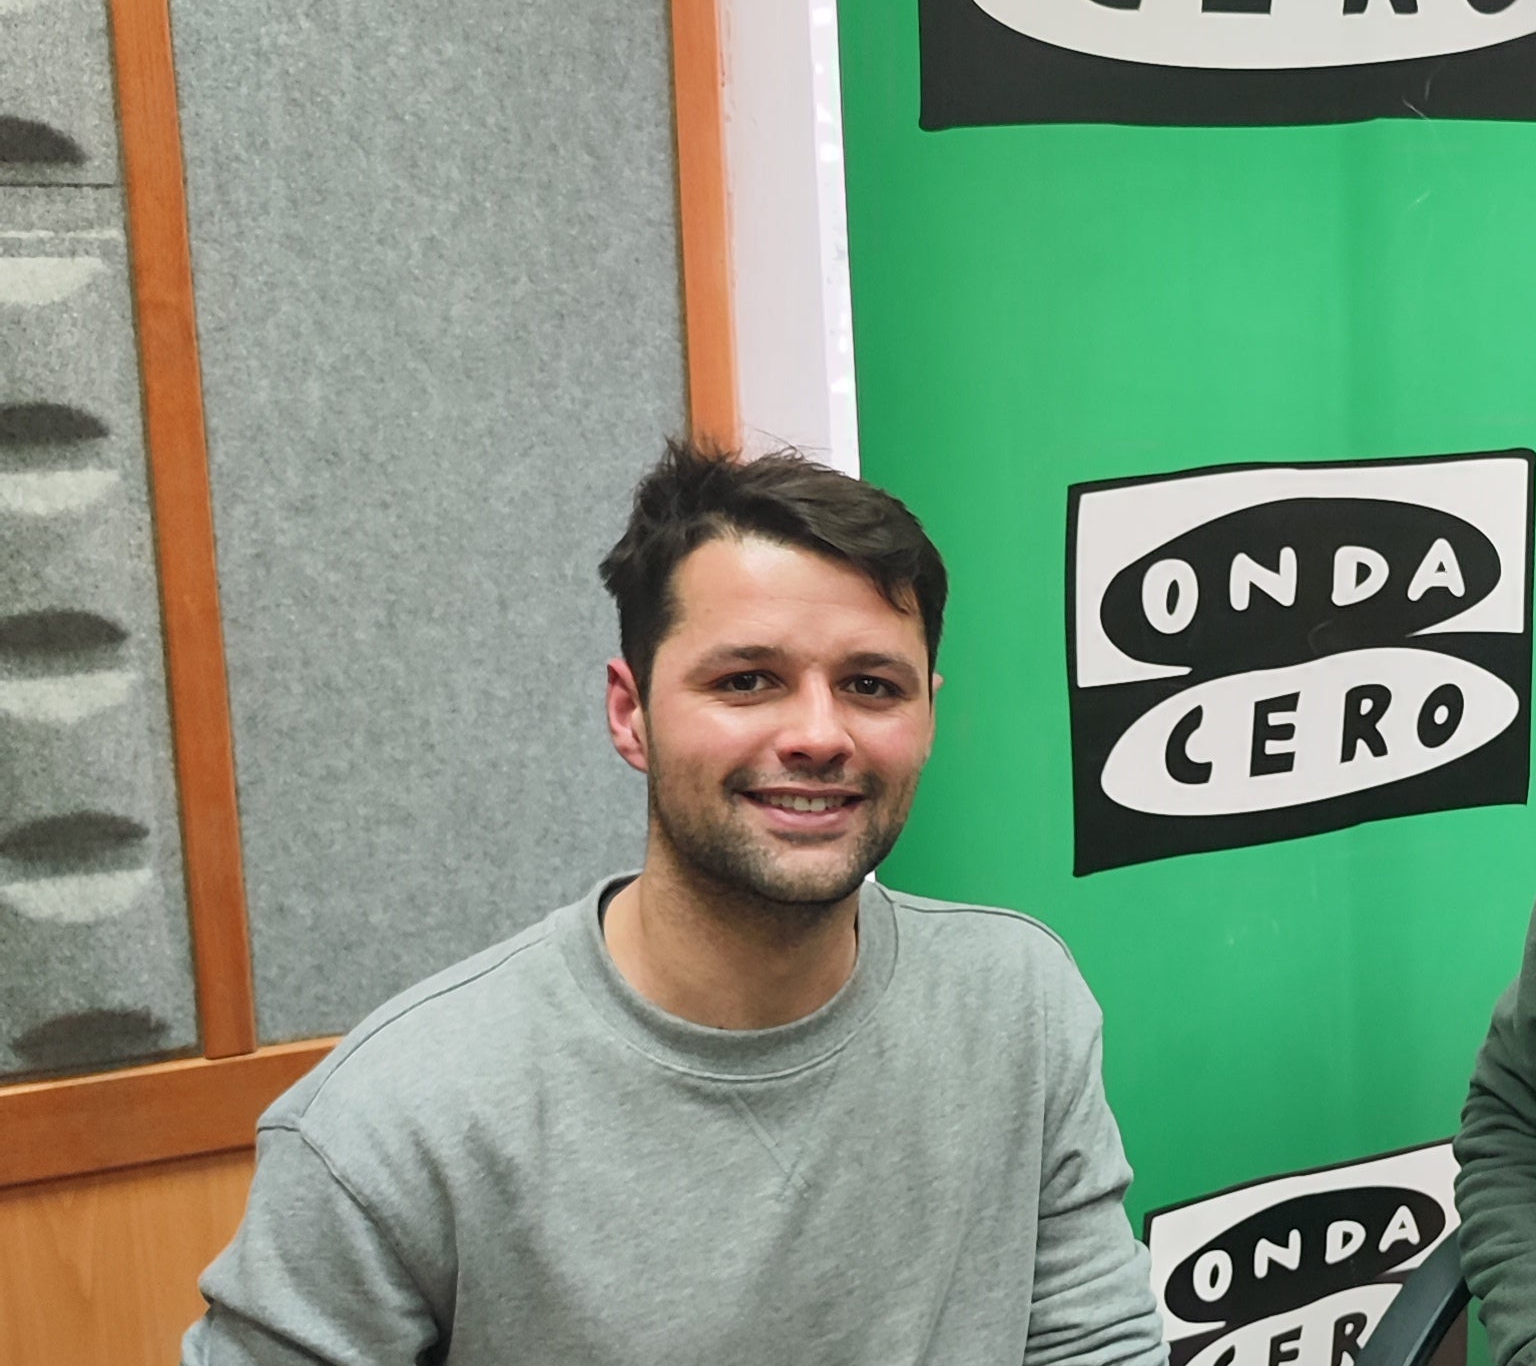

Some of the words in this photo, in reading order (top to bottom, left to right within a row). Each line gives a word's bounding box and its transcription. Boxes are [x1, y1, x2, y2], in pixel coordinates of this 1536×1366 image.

[1142, 537, 1466, 635] ONDA
[1165, 683, 1465, 785] CERO
[1193, 1204, 1421, 1303] ONDA
